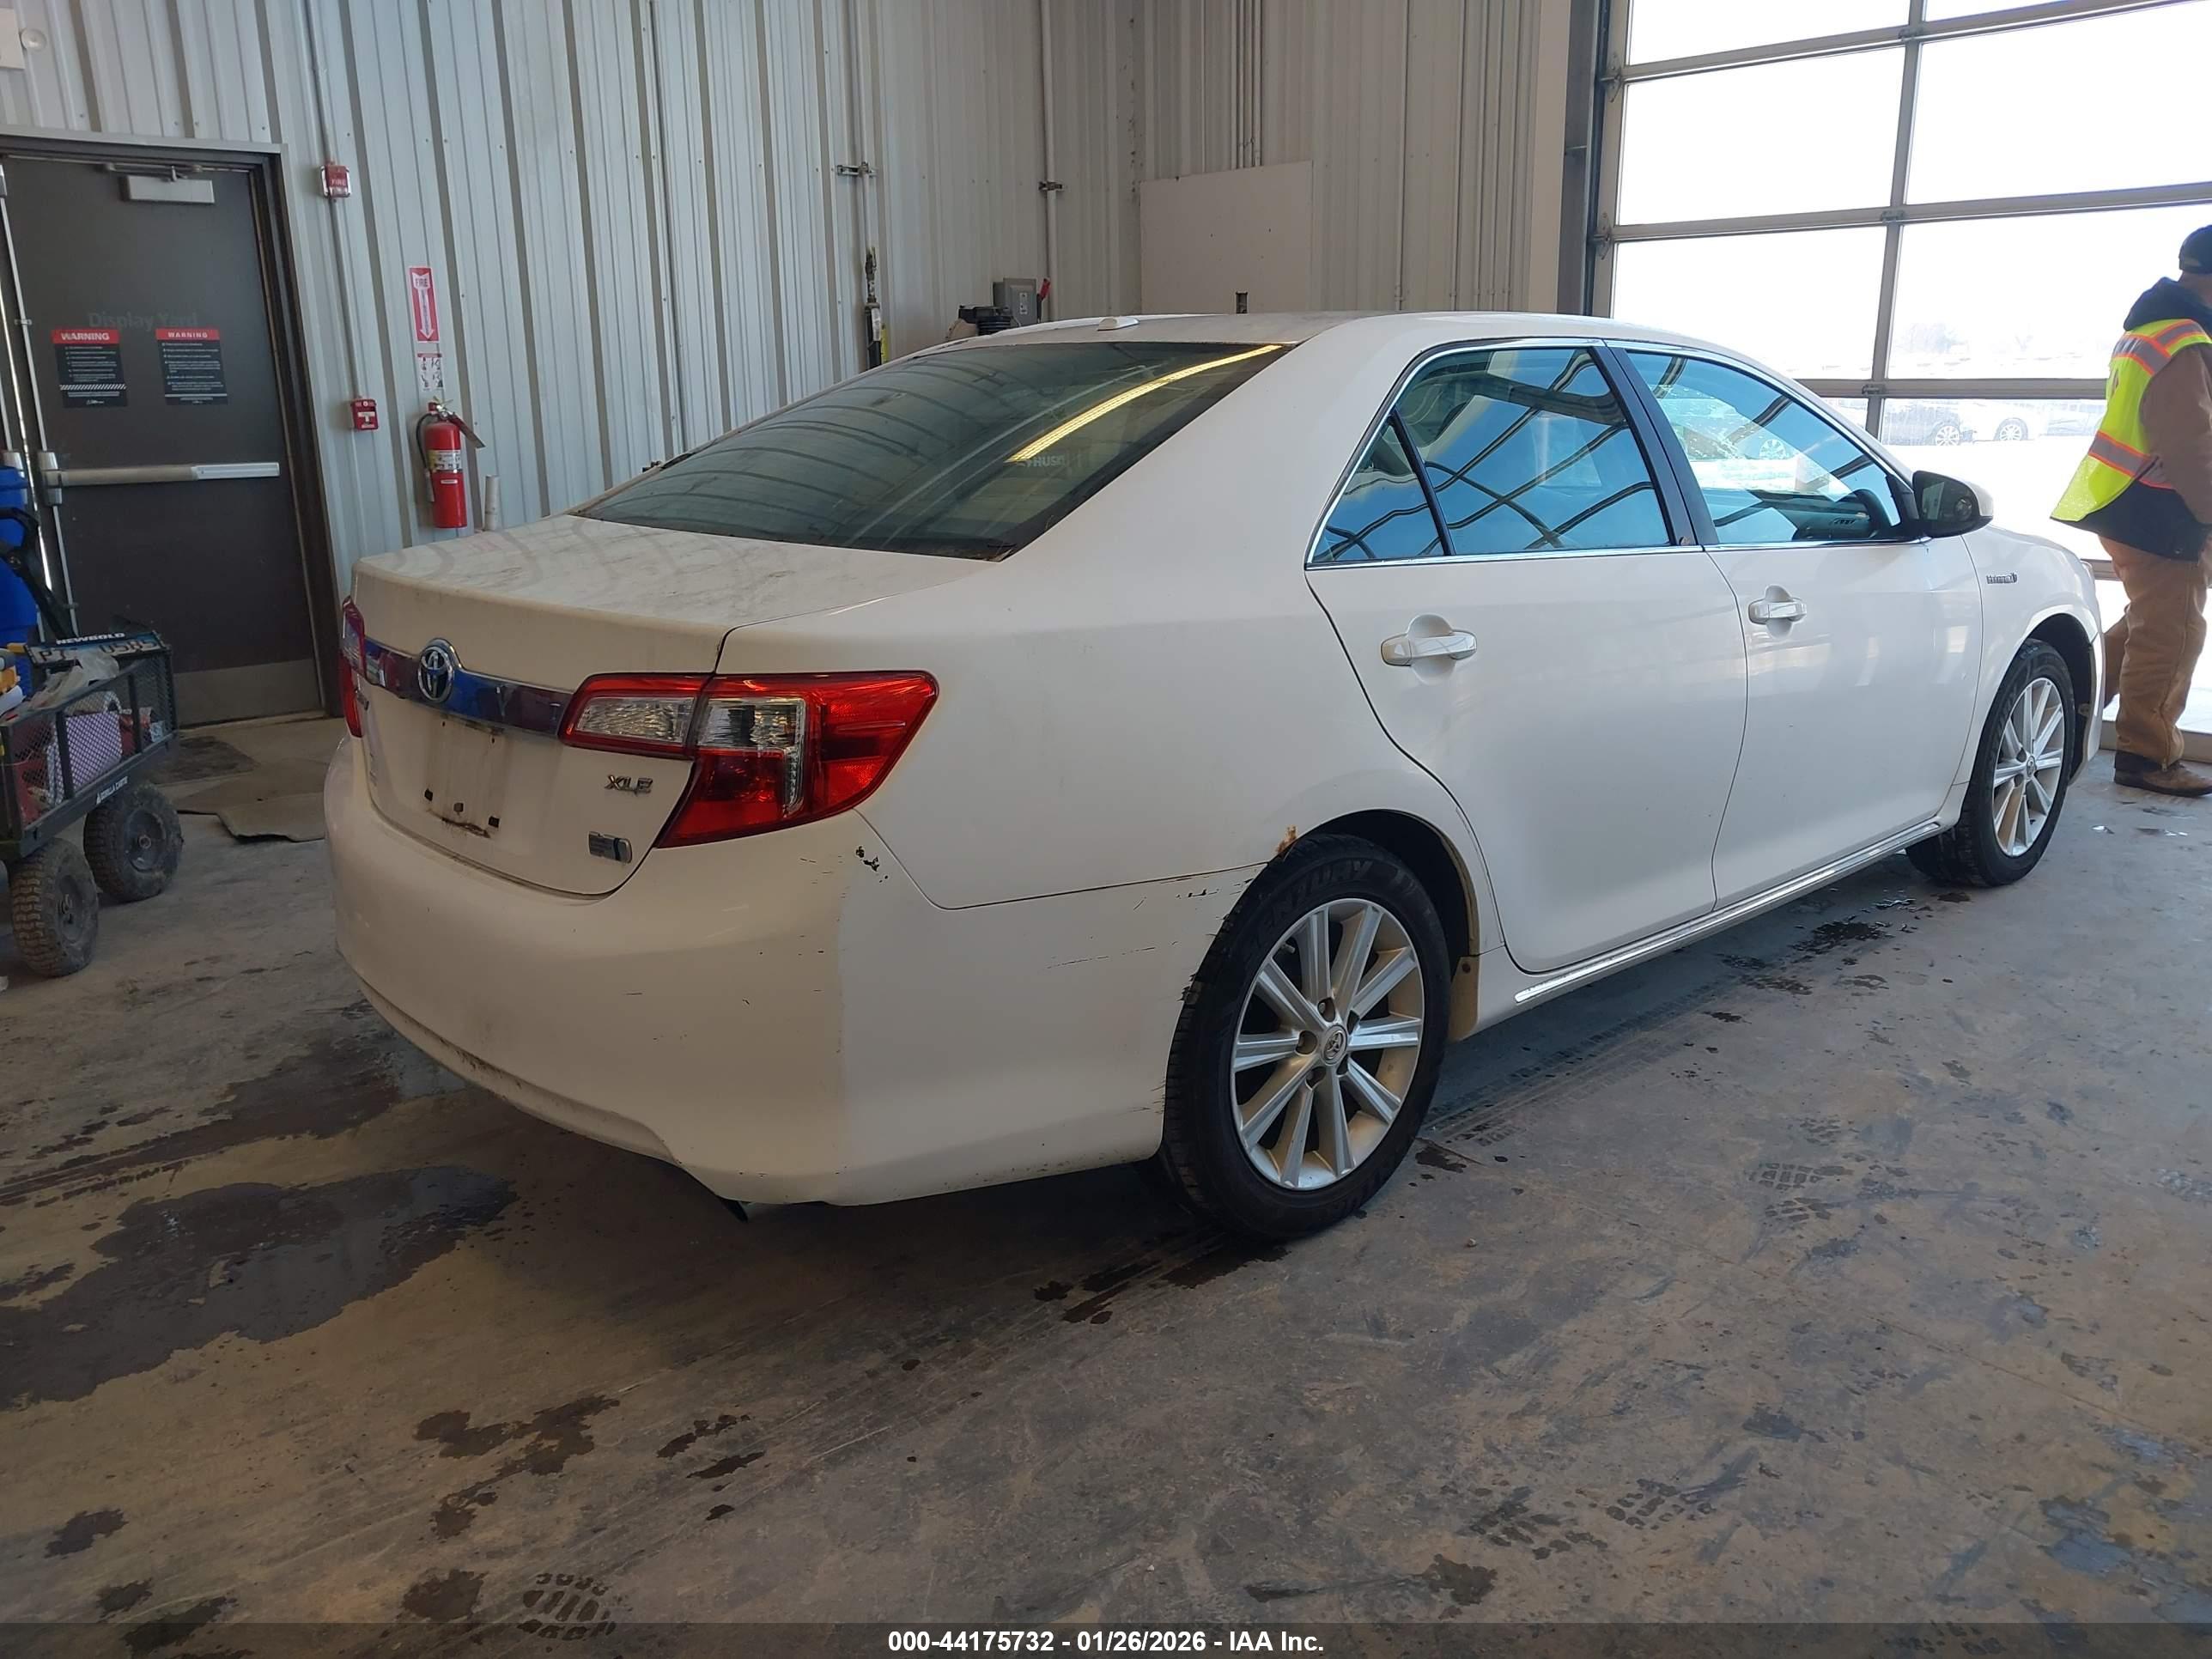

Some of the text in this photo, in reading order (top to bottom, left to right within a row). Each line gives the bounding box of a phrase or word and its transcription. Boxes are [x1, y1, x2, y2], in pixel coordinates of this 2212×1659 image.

[330, 178, 347, 186] FIRE
[415, 277, 428, 288] FIRE
[88, 312, 198, 331] Display Yard
[61, 331, 110, 341] WARNING
[56, 632, 126, 645] NEWBOLD
[605, 775, 653, 794] XLE
